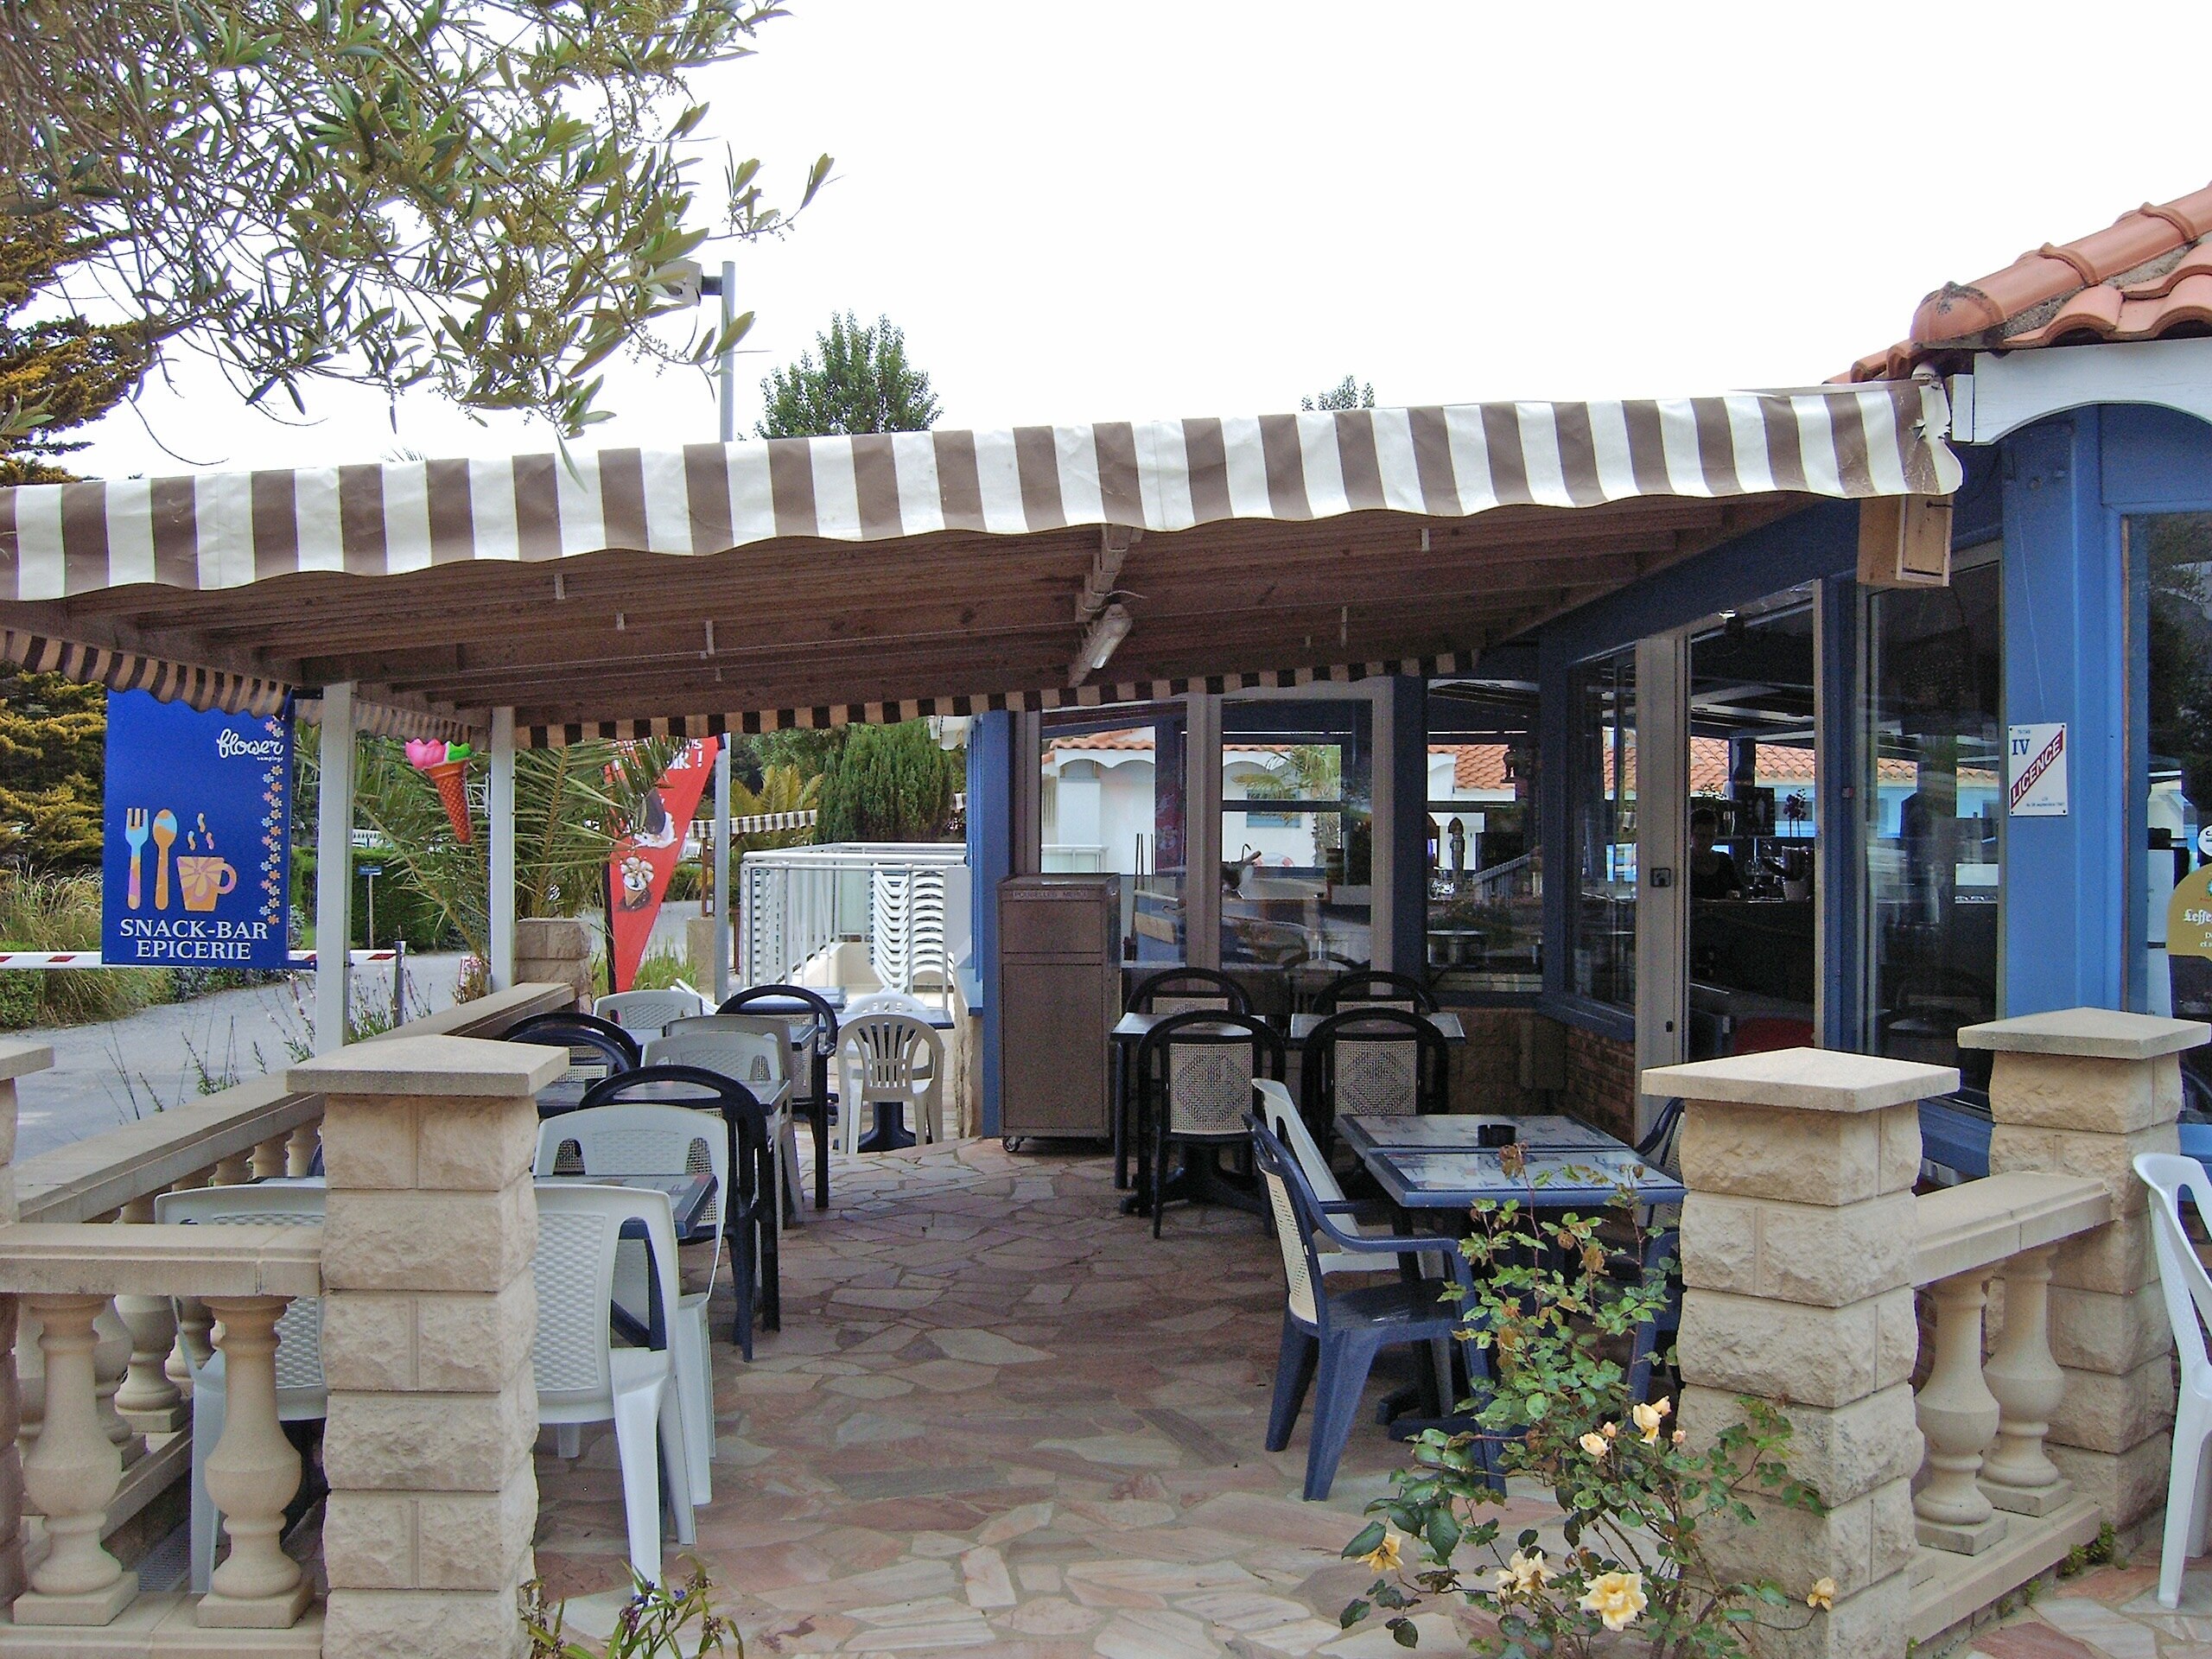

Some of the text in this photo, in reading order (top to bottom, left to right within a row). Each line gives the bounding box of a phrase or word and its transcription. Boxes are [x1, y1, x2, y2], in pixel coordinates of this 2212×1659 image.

[216, 728, 283, 759] flower
[2012, 739, 2030, 755] IV
[2012, 736, 2060, 804] LICENCE
[120, 918, 269, 940] SNACK-BAR
[136, 939, 251, 960] EPICERIE
